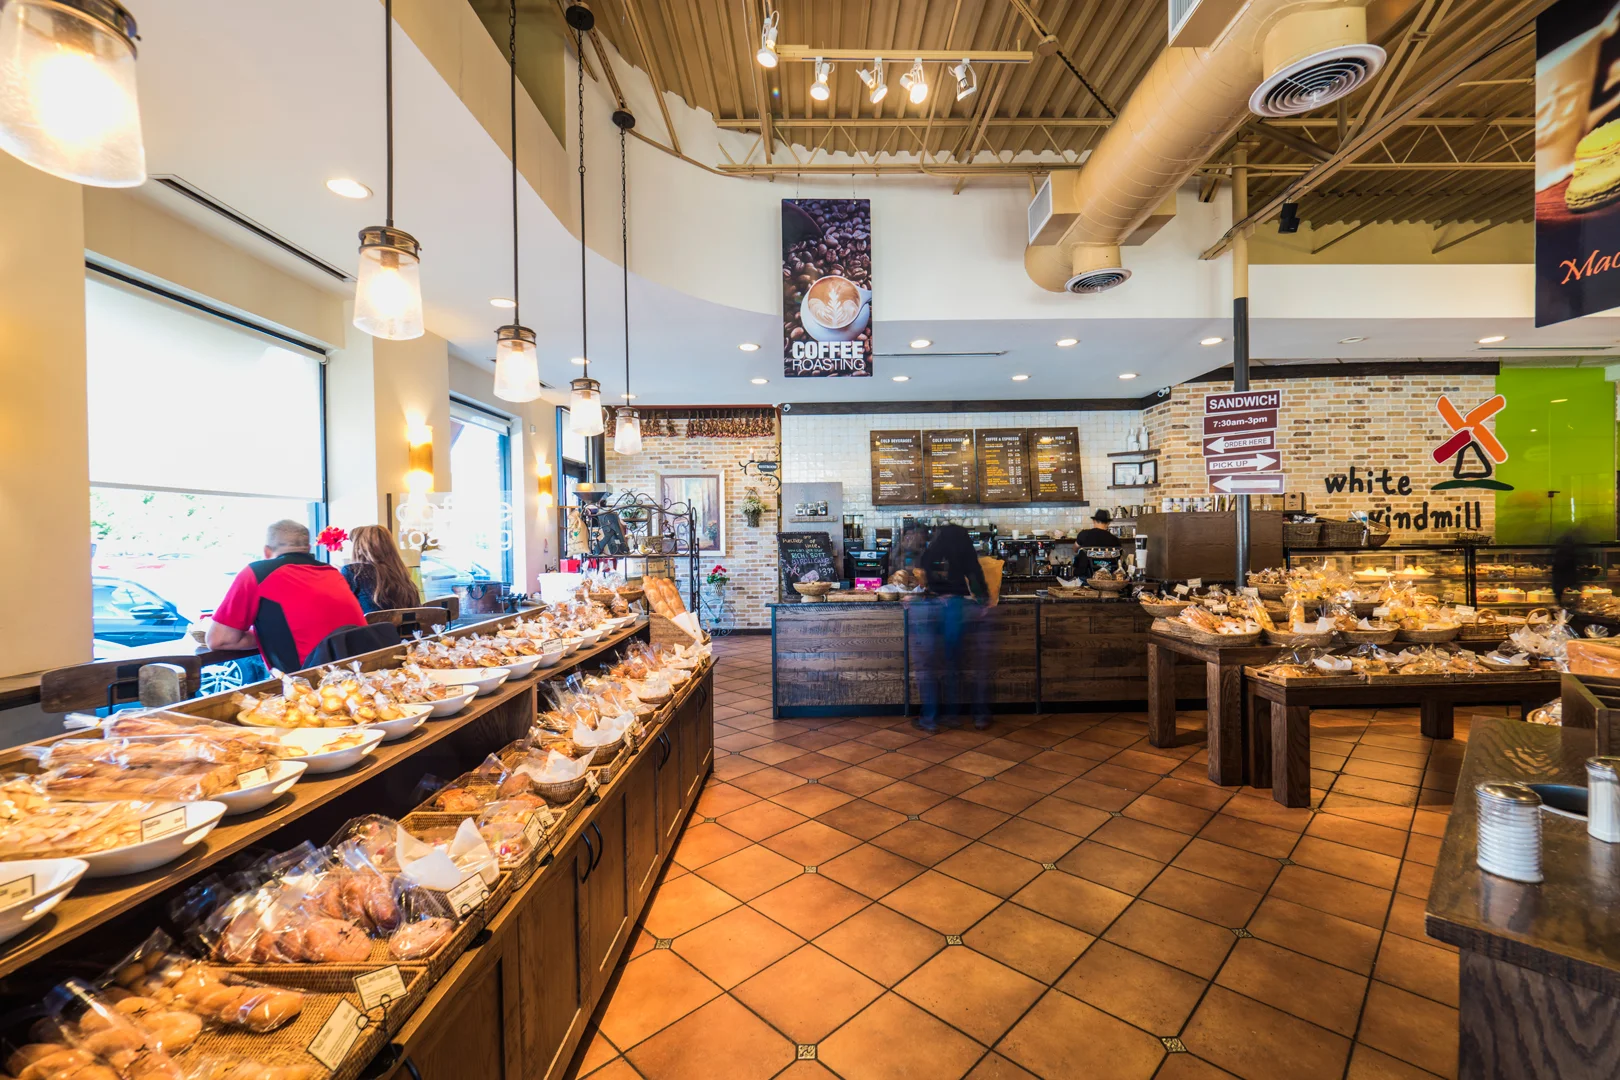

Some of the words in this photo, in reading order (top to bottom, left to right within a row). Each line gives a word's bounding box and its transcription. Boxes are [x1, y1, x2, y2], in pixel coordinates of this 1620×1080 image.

[792, 341, 864, 359] COFFEE
[792, 358, 865, 371] ROASTING
[1209, 394, 1277, 410] SANDWICH
[1213, 416, 1268, 428] 7:30am-3pm
[1224, 440, 1248, 448] ORDER
[1212, 461, 1233, 469] PICK
[1324, 466, 1412, 496] white
